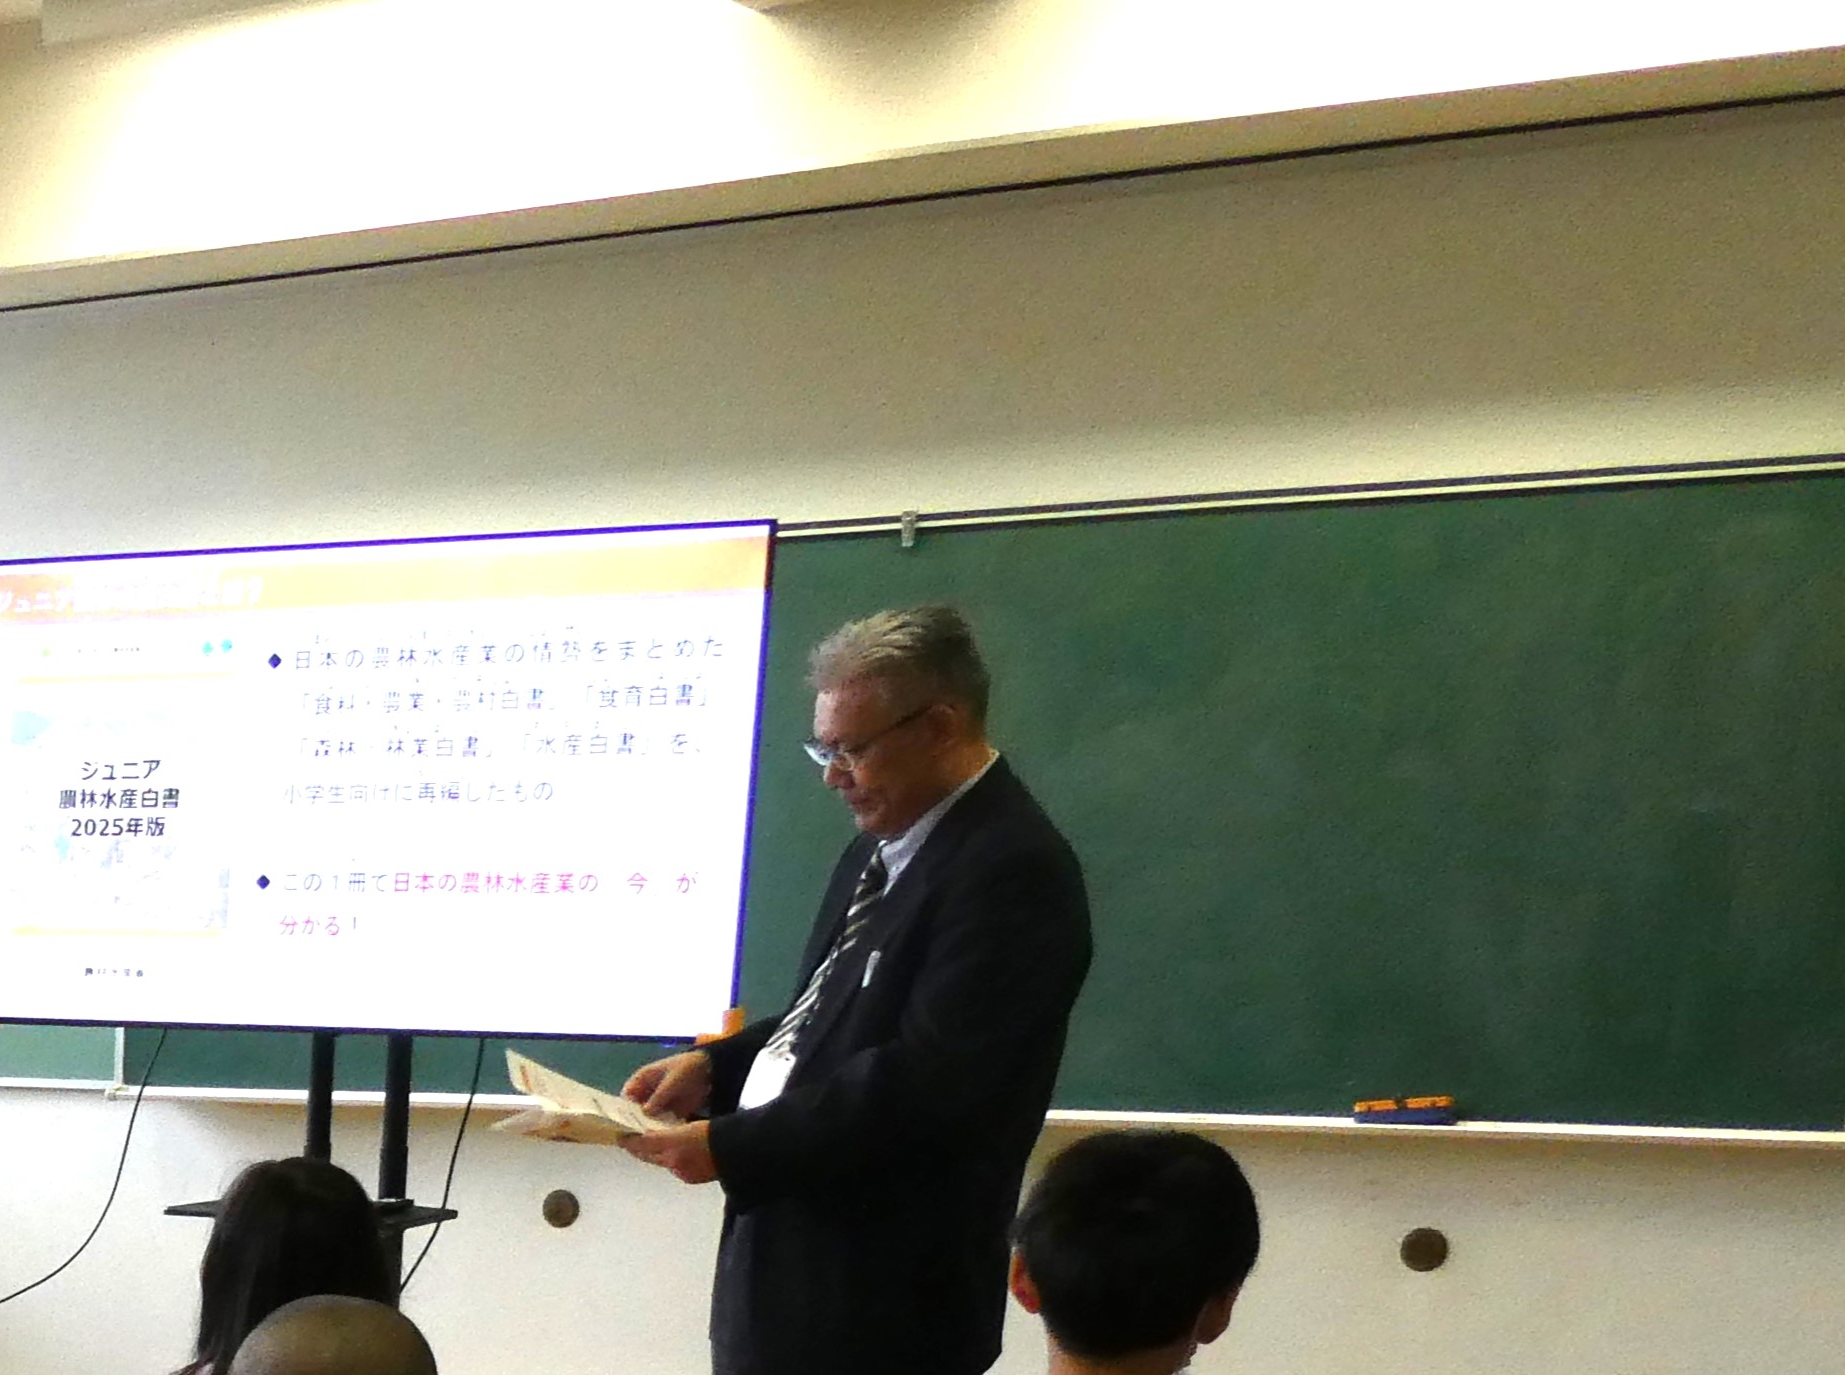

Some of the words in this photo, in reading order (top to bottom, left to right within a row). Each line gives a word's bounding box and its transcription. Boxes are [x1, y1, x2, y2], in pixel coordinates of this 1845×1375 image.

[80, 759, 165, 781] ジュニア
[58, 787, 181, 810] 農林水産白書
[70, 816, 167, 838] 2025年版
